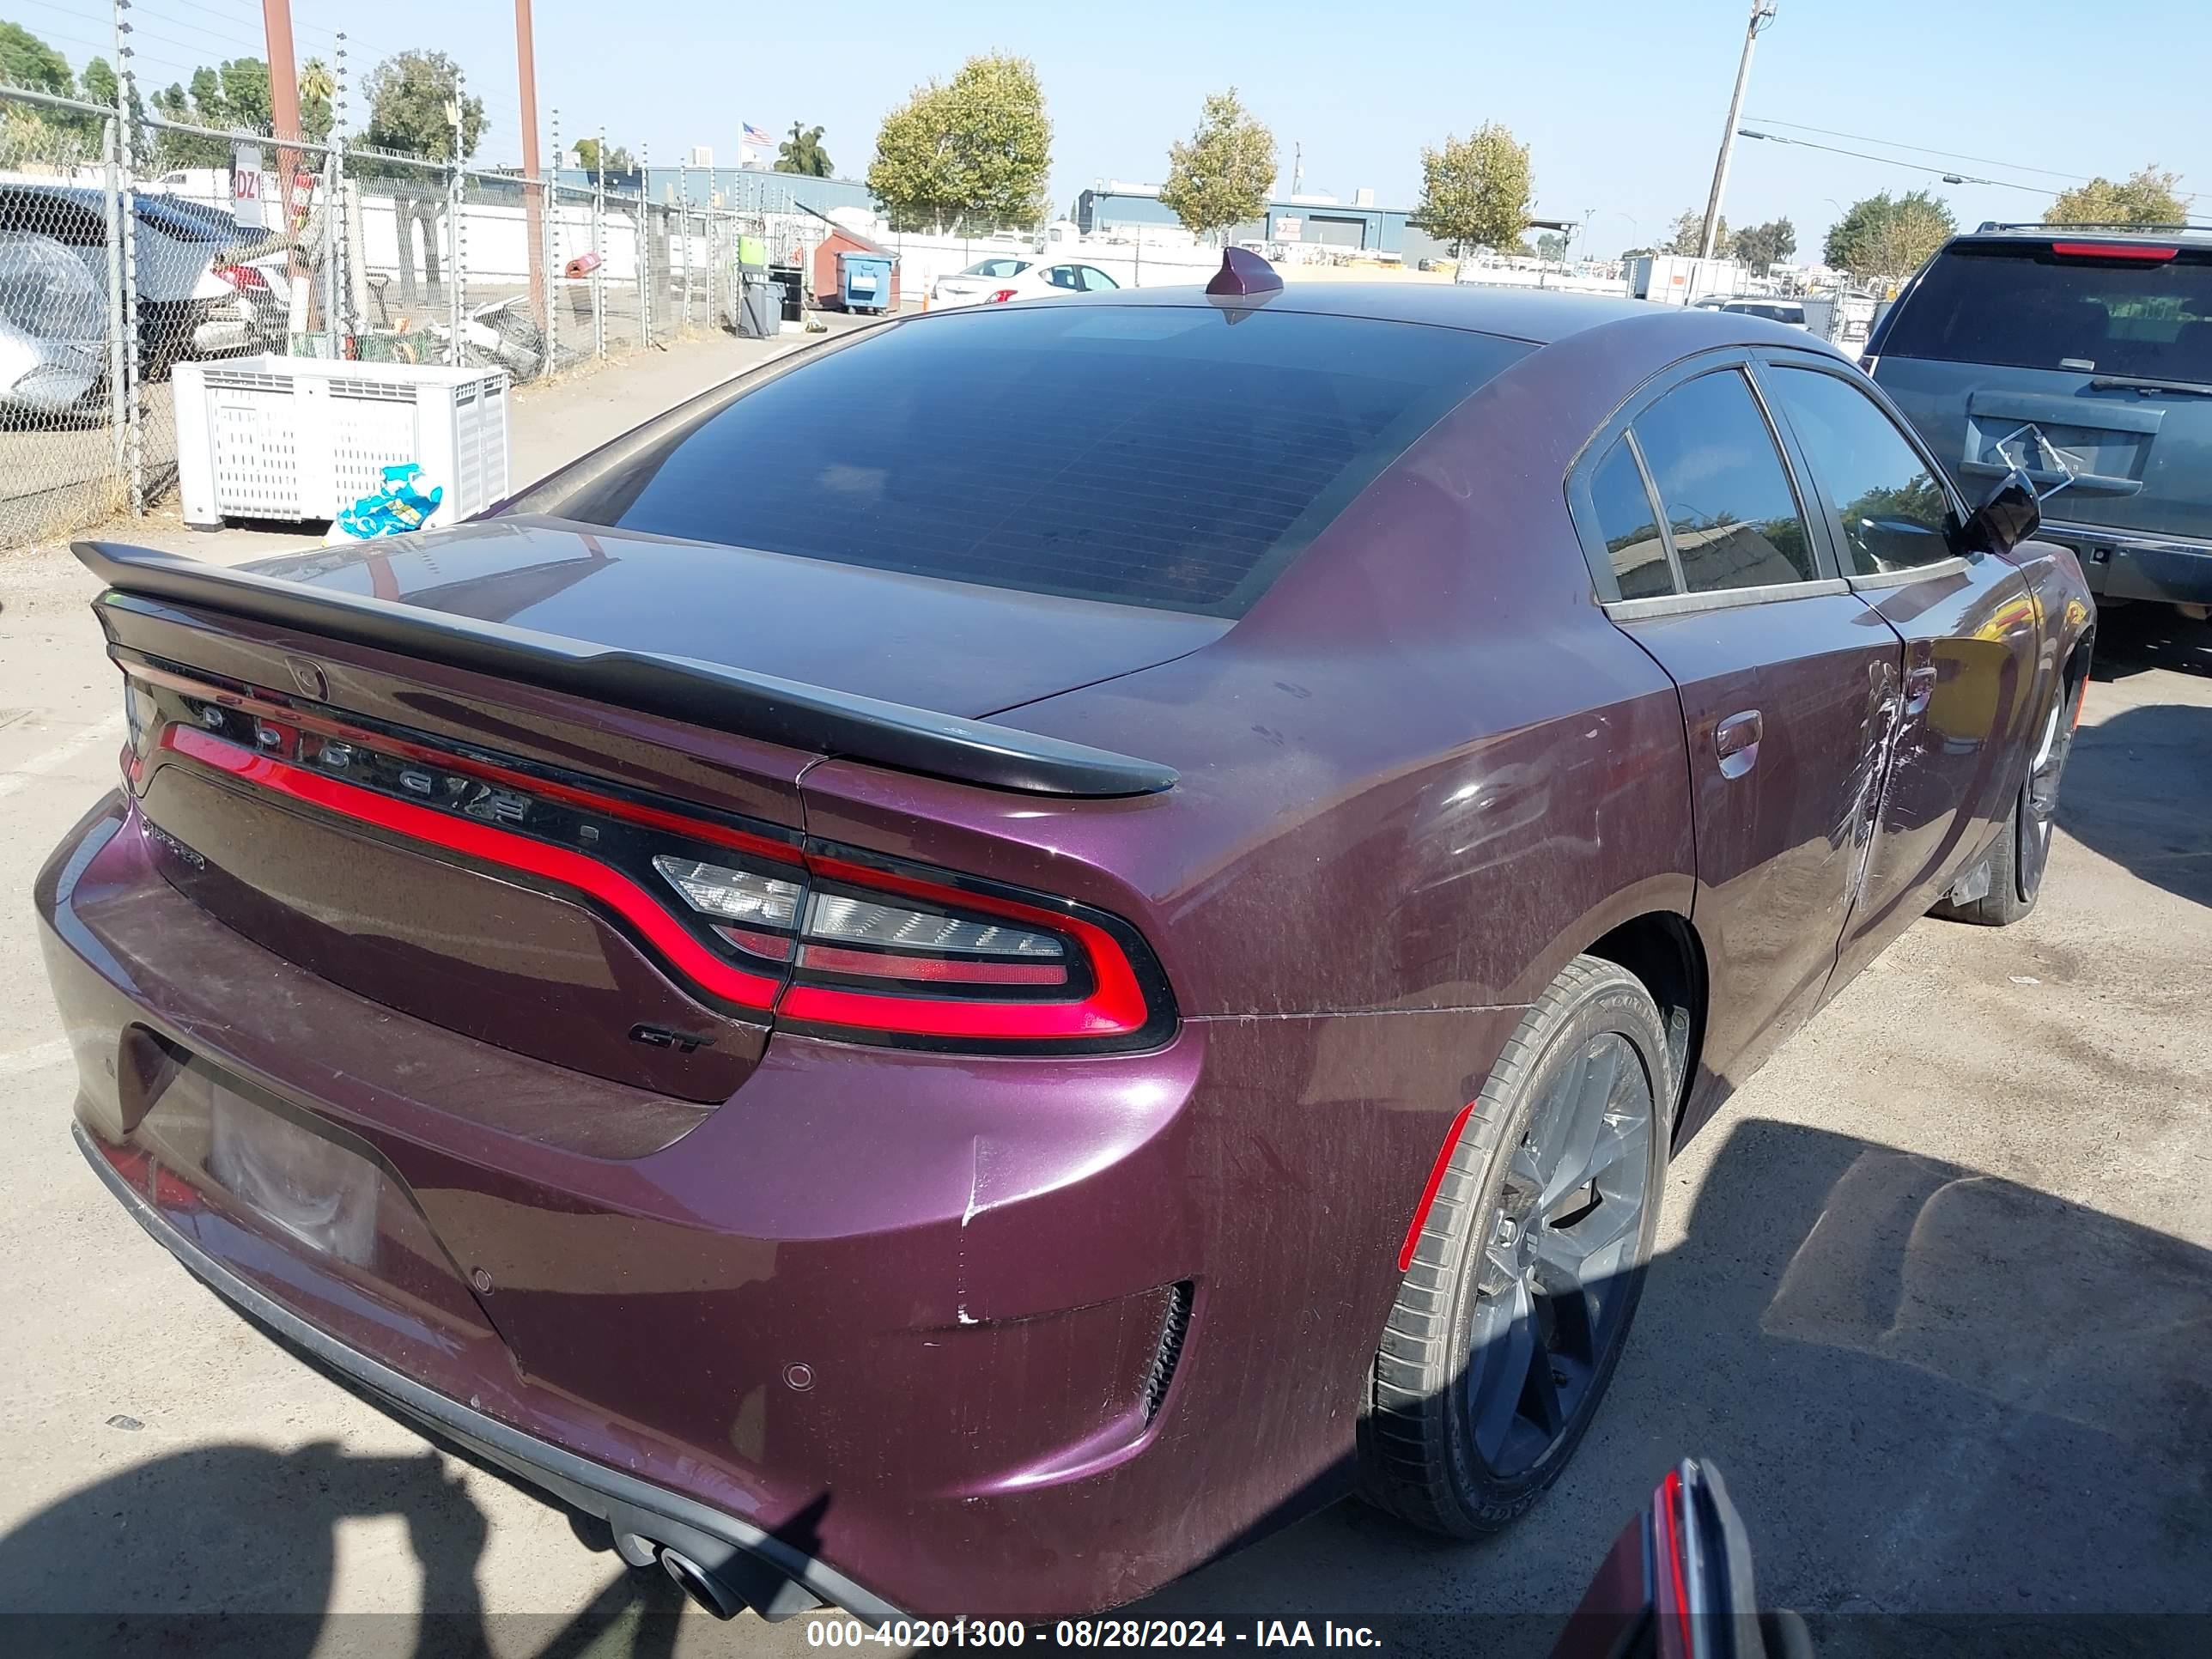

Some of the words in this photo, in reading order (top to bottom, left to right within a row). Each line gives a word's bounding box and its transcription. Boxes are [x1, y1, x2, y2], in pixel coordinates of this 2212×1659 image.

[236, 169, 261, 199] DZ1
[203, 705, 525, 823] DODGE
[628, 1022, 715, 1054] GT
